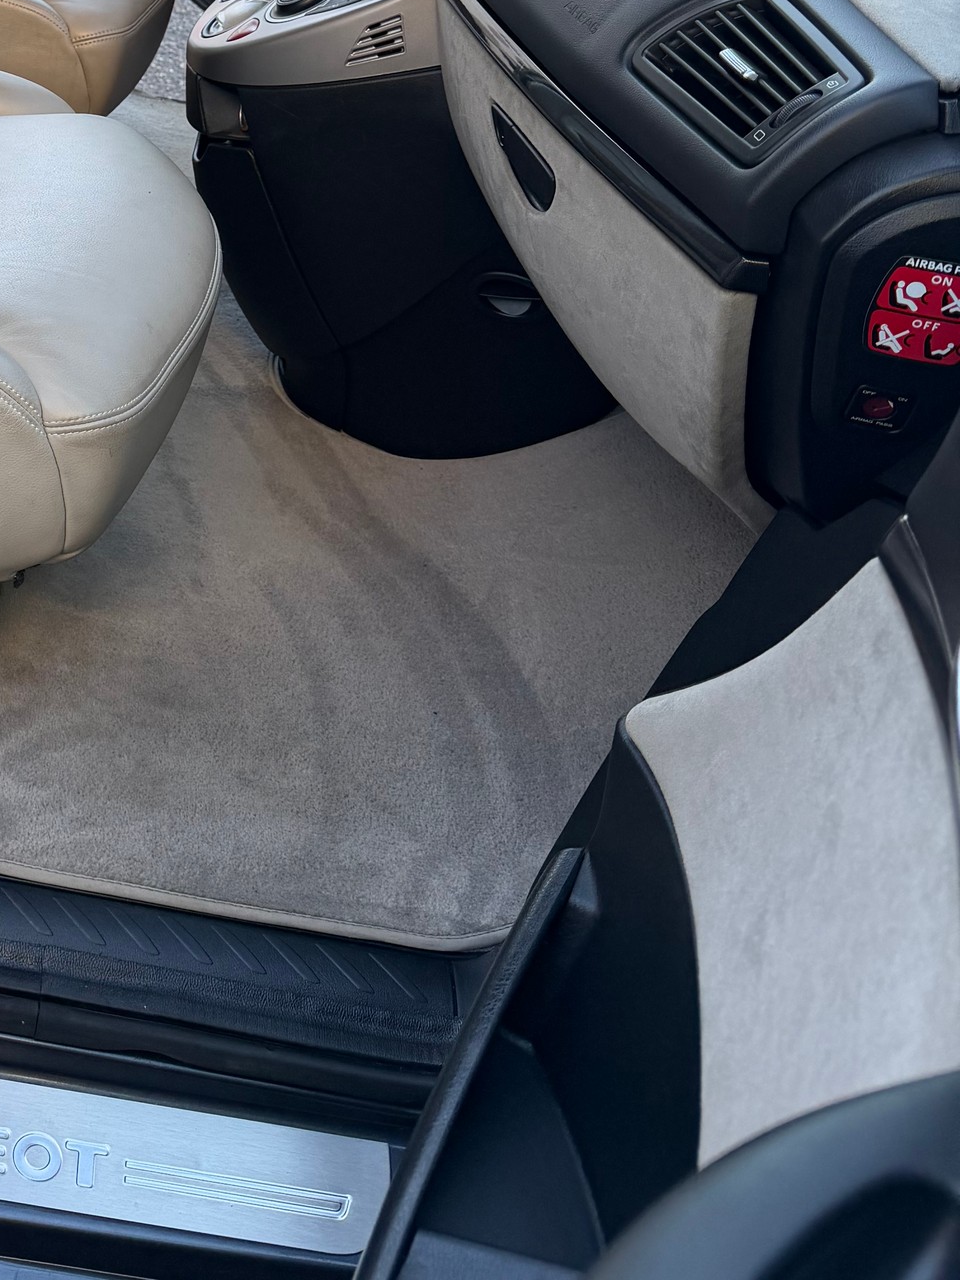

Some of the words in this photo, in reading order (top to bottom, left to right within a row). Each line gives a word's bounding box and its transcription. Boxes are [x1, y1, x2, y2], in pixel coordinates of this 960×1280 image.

[905, 257, 953, 274] AIRBAG
[931, 275, 953, 287] ON
[912, 319, 941, 332] OFF
